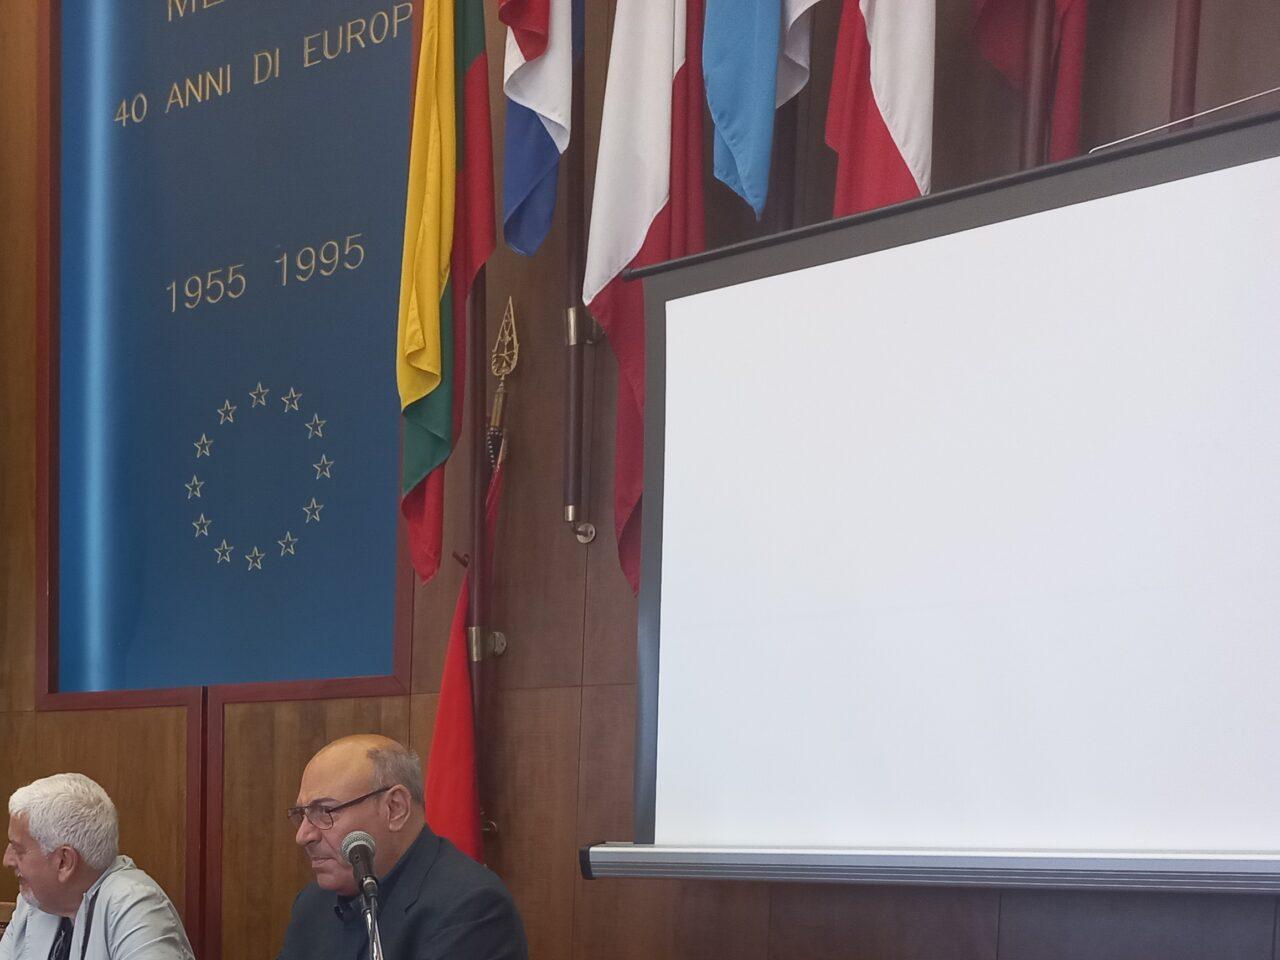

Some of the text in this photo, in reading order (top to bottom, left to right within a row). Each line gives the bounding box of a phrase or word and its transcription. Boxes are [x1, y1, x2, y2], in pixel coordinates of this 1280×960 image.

[113, 92, 148, 128] 40
[164, 63, 232, 114] ANNI
[253, 47, 280, 86] DI
[166, 232, 367, 314] 1955 1995
